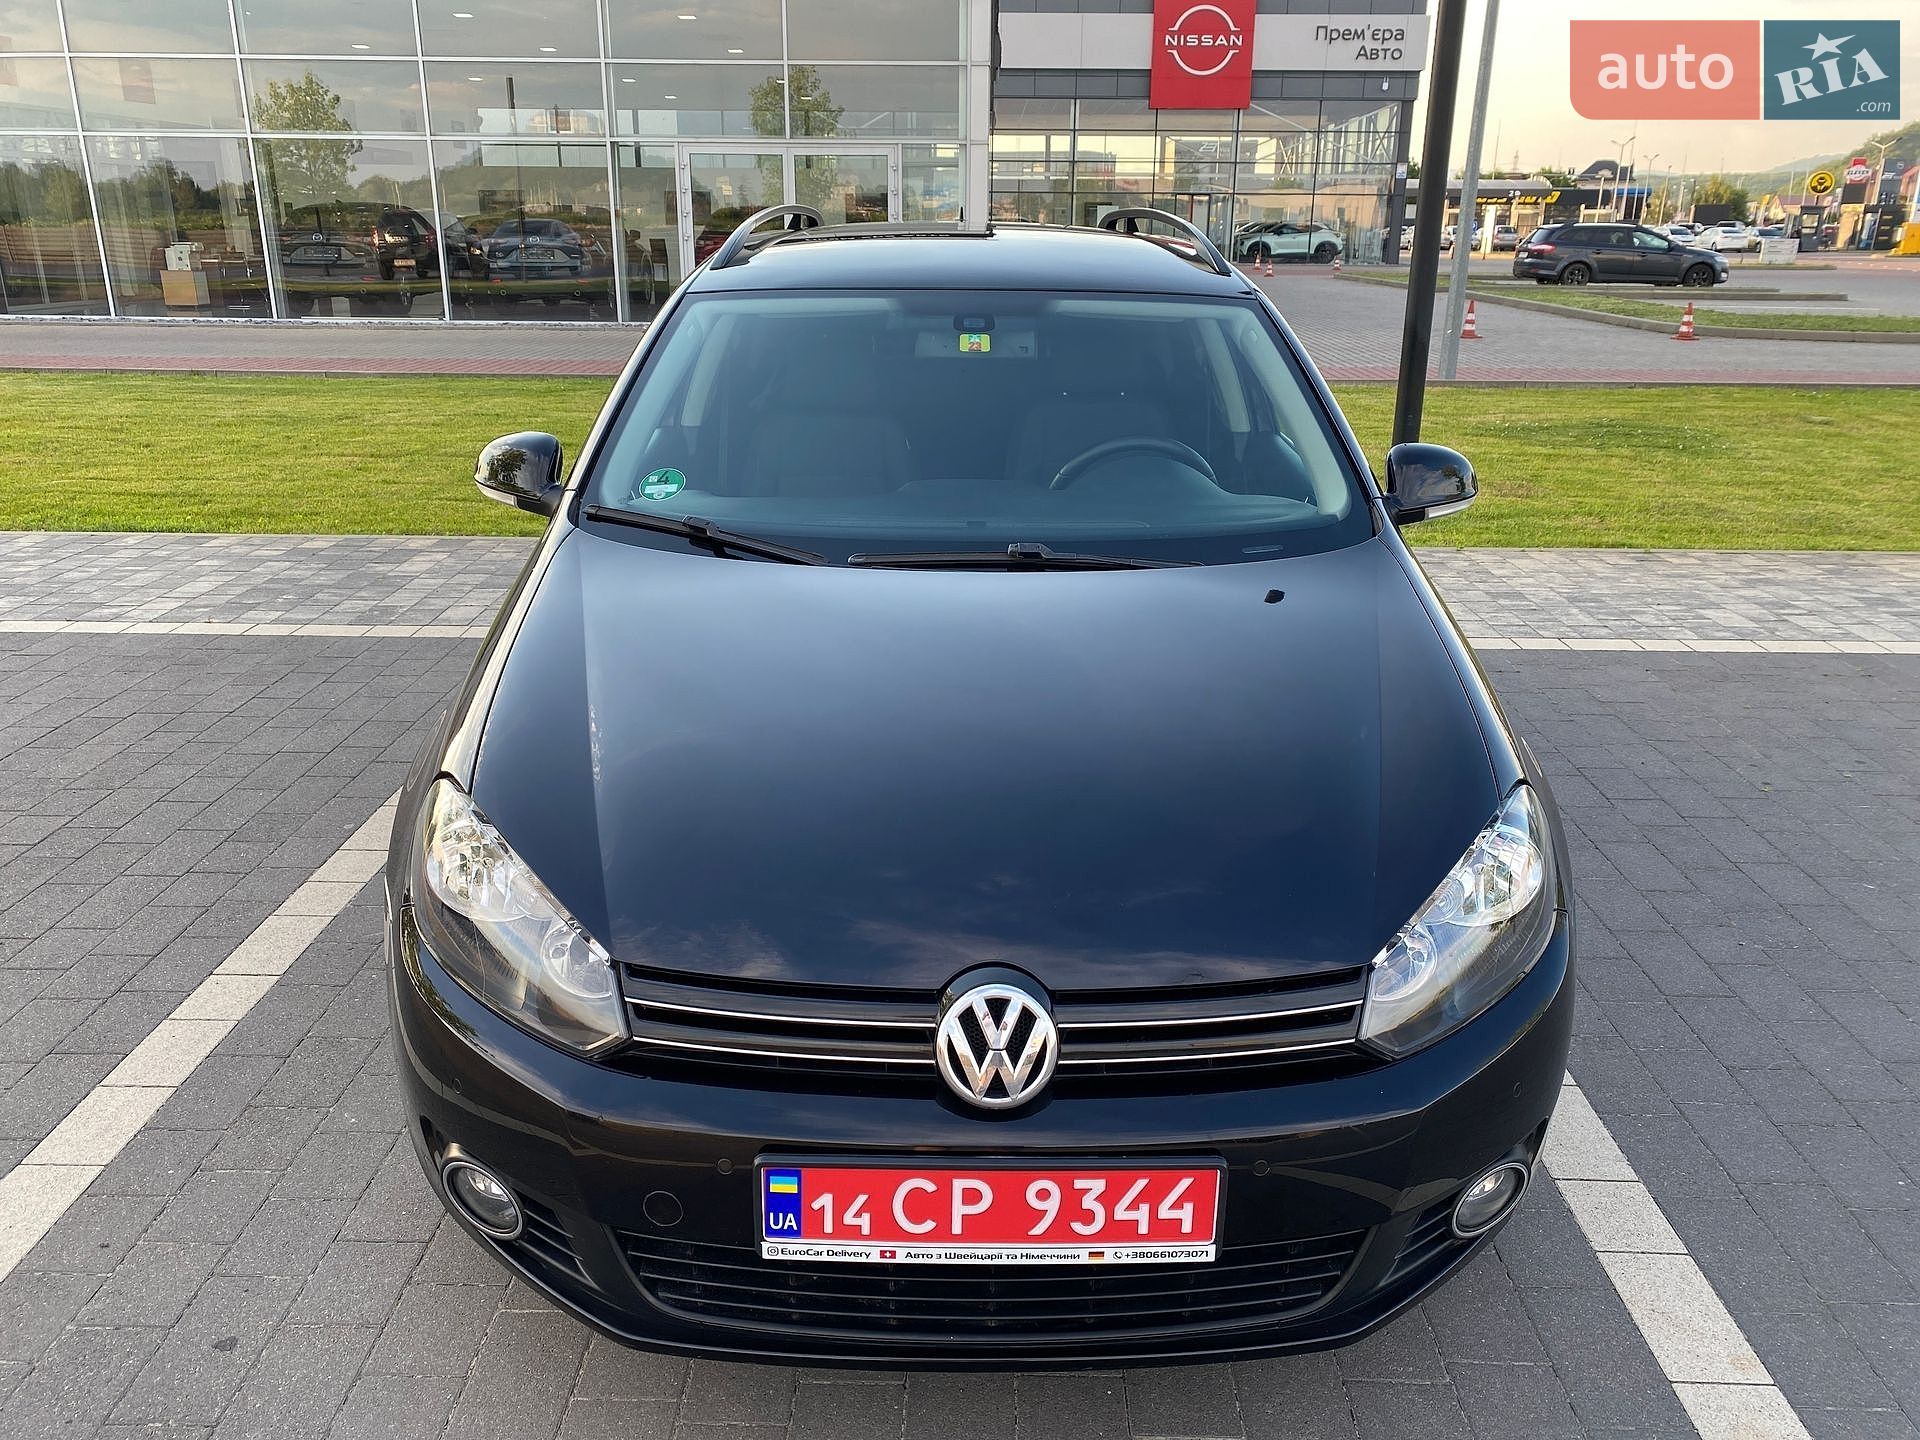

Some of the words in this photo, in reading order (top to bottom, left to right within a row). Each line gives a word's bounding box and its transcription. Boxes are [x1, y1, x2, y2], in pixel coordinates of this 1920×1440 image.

[1164, 33, 1243, 47] NISSAN
[1314, 23, 1405, 45] Прем'єра
[1355, 45, 1403, 61] Авто
[656, 470, 670, 485] 4
[944, 992, 1051, 1103] VW
[810, 1193, 872, 1236] 14
[891, 1177, 994, 1235] CP
[1025, 1177, 1196, 1236] 9344
[769, 1212, 798, 1231] UA
[780, 1247, 825, 1257] EuroCar
[826, 1249, 871, 1259] Delivery
[904, 1251, 934, 1260] Авто
[944, 1251, 1003, 1262] Швейцарії
[1005, 1253, 1018, 1261] та
[1020, 1251, 1081, 1261] Німеччини
[1124, 1250, 1209, 1260] +380661073071
